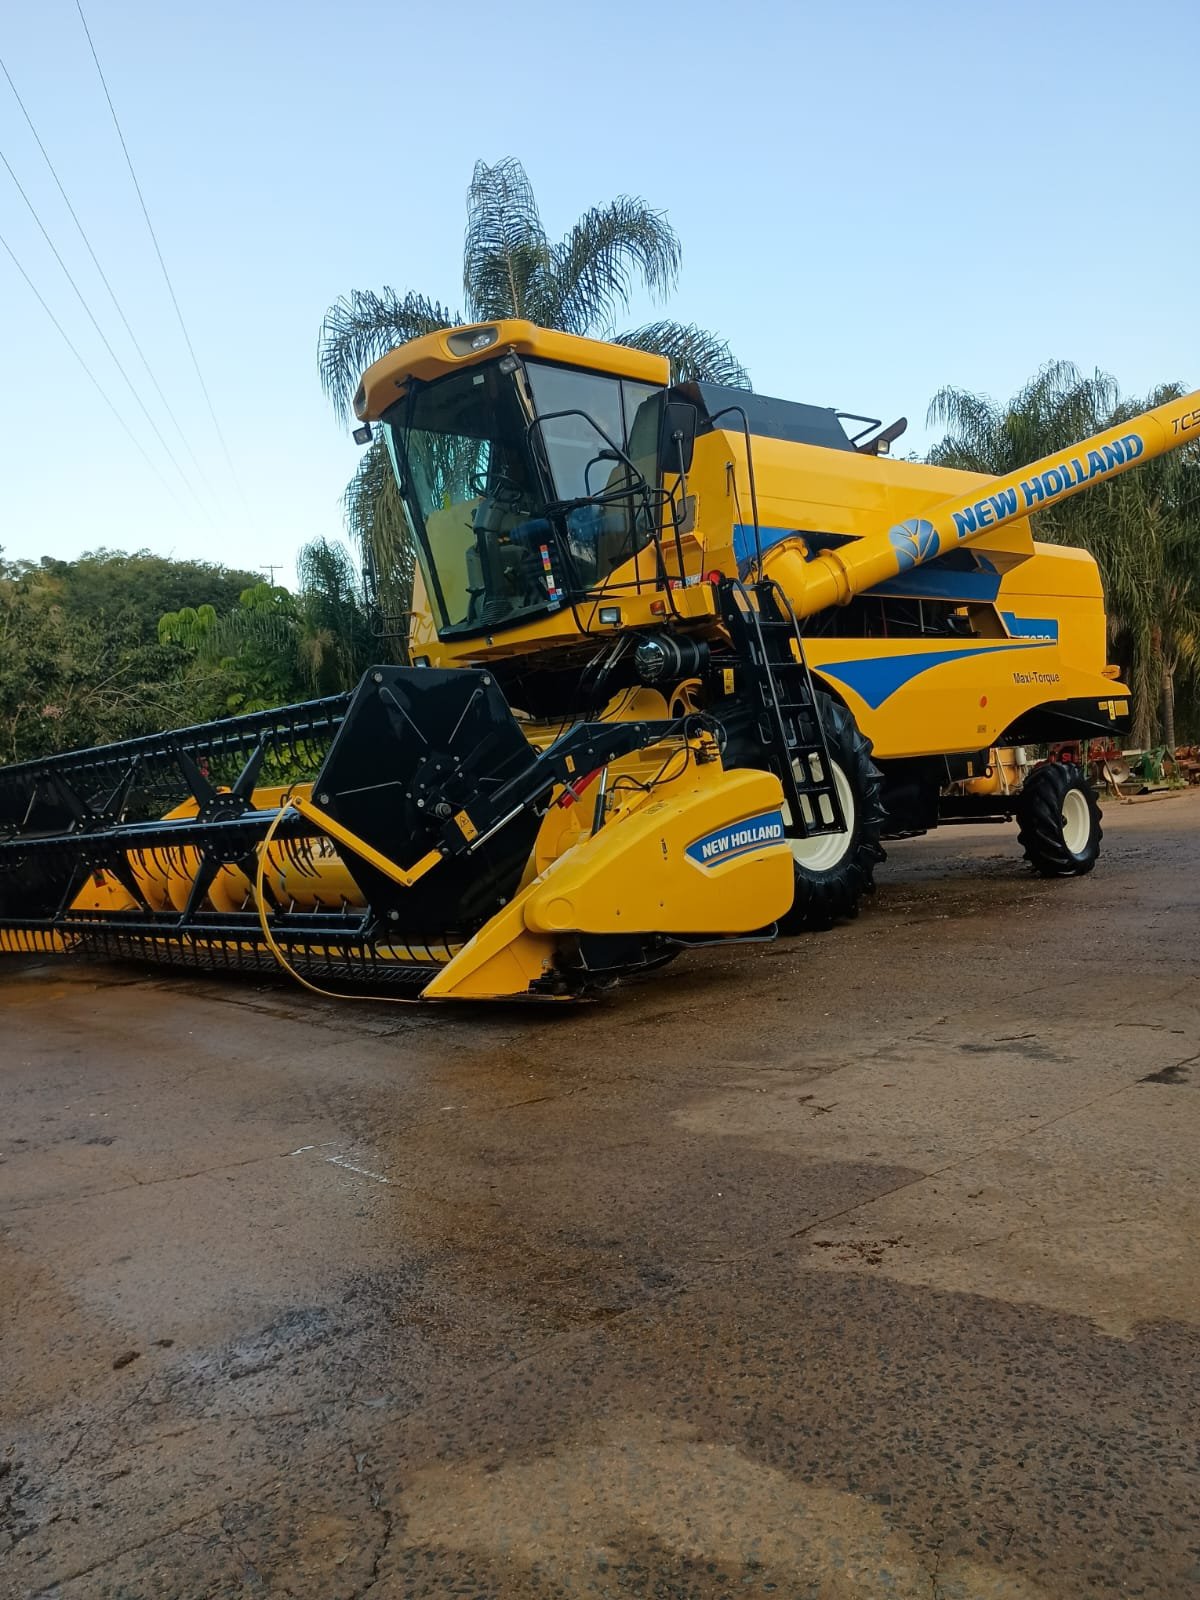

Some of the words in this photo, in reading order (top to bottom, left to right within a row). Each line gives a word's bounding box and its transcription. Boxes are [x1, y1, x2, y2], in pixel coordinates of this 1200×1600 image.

[952, 487, 1018, 539] NEW
[1020, 434, 1144, 507] HOLLAND
[1013, 671, 1060, 685] Maxi-Torque
[702, 836, 729, 858] NEW
[731, 824, 781, 847] HOLLAND
